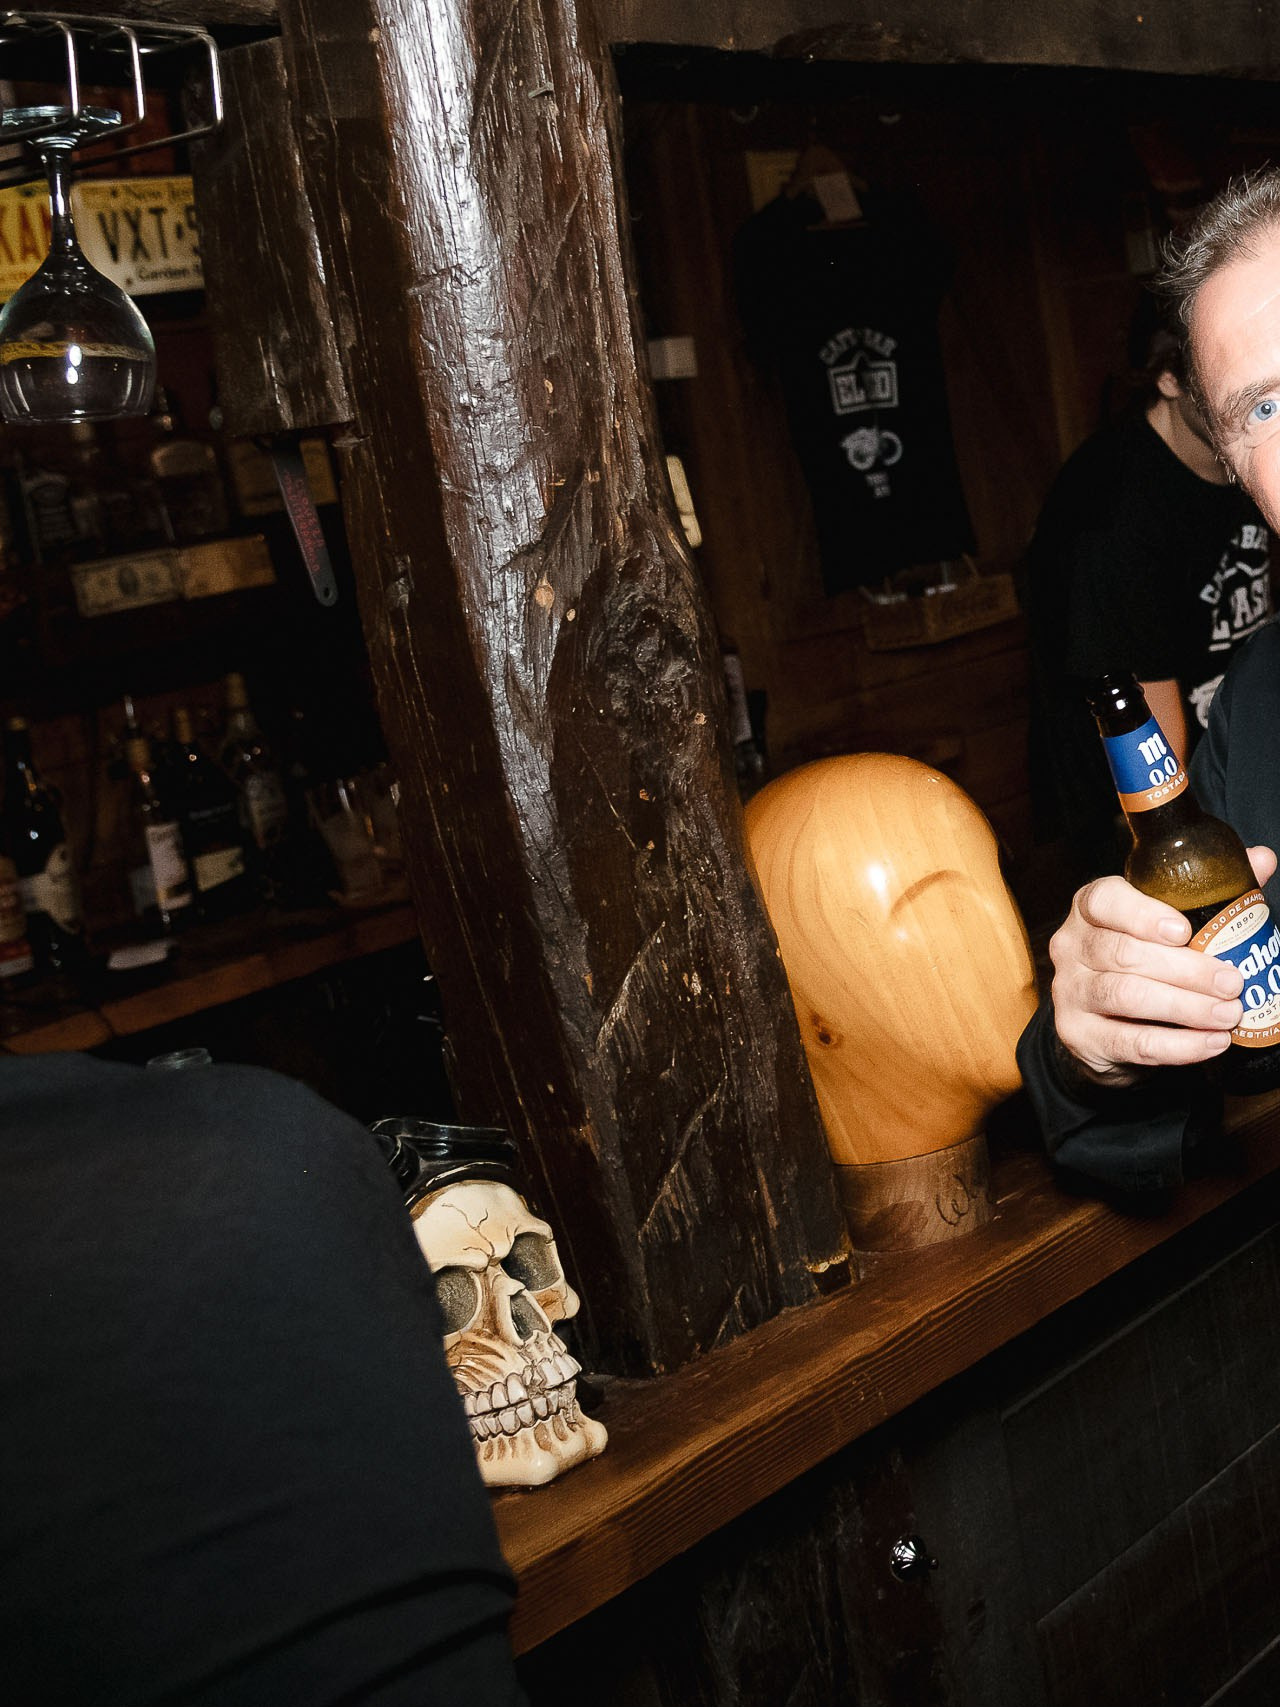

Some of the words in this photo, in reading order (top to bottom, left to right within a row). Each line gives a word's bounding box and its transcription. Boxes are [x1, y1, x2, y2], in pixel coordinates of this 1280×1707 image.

[1198, 931, 1212, 946] LA
[1228, 903, 1243, 917] DE
[1230, 912, 1254, 932] 1890
[1232, 1026, 1280, 1039] AESTRÍA
